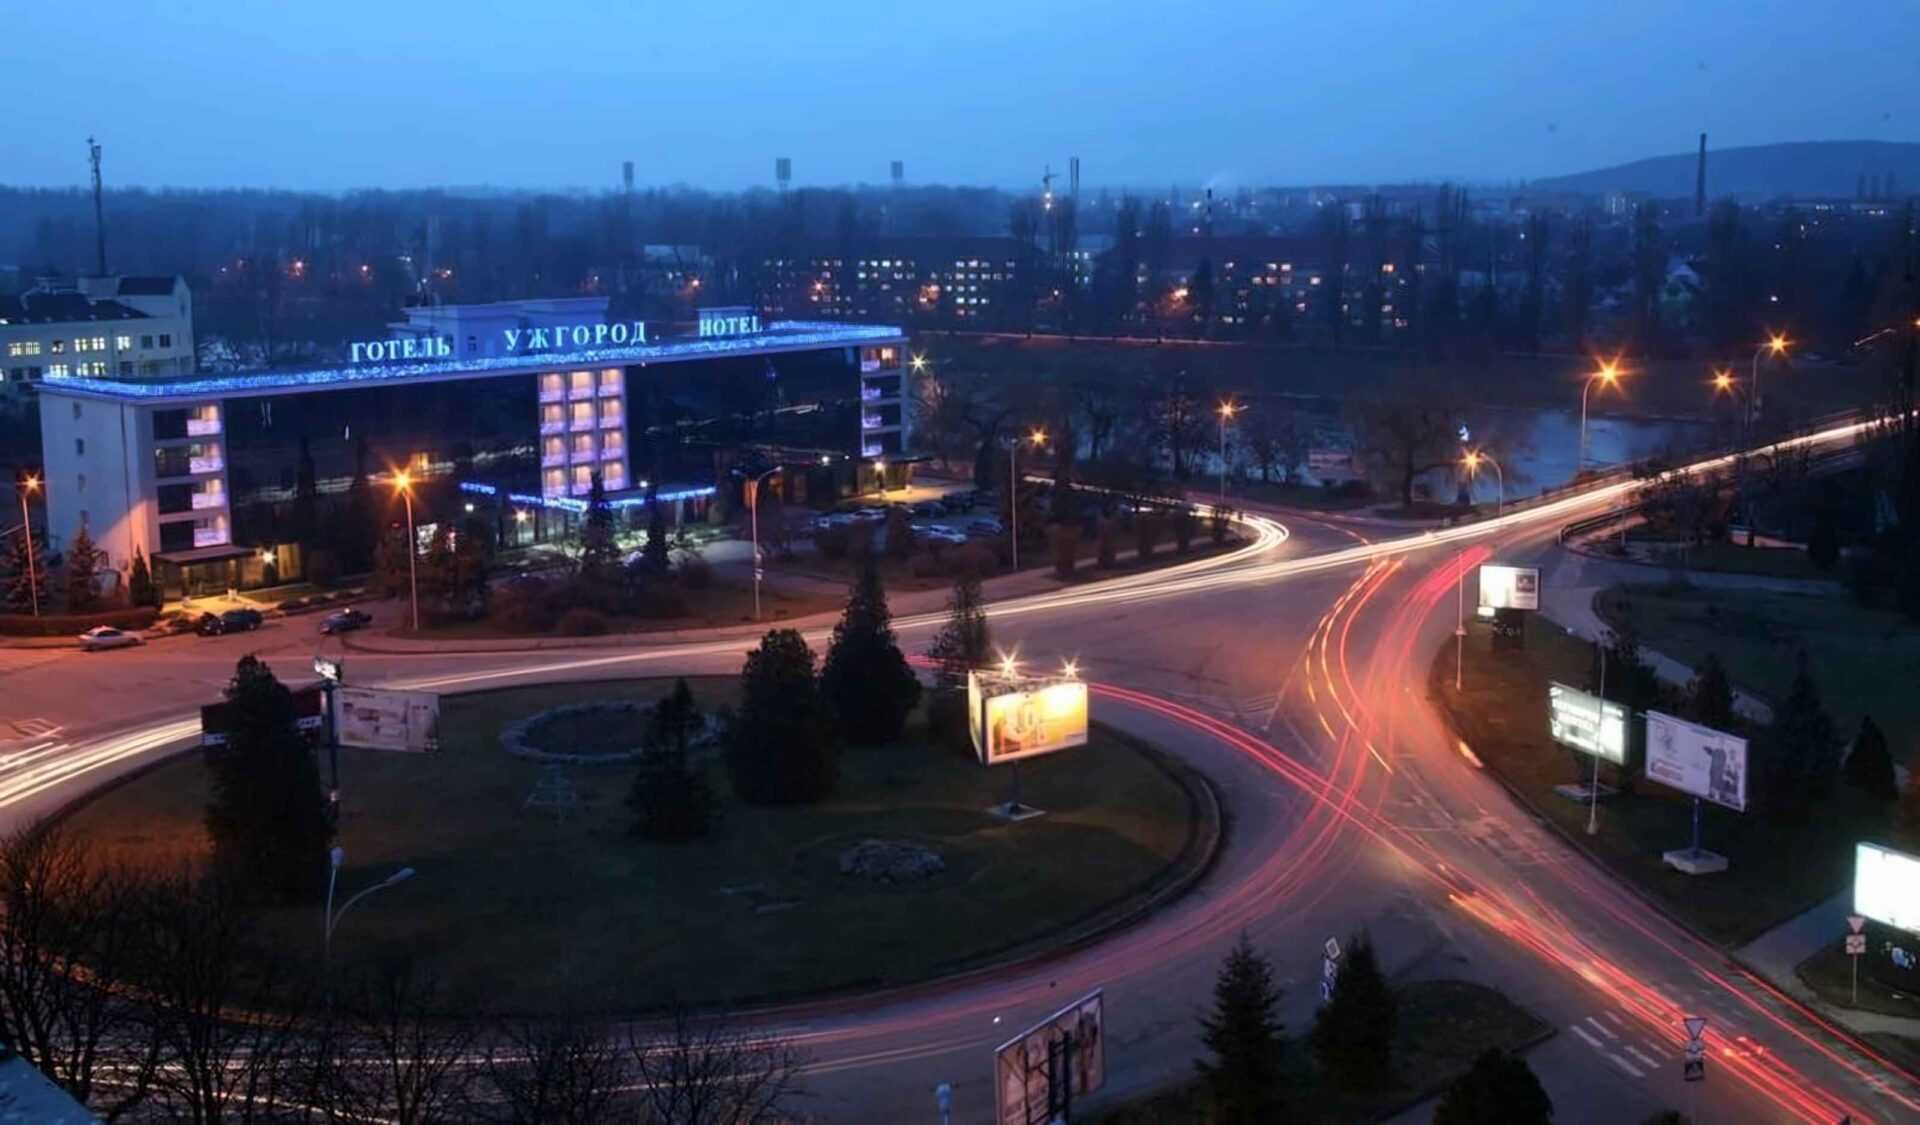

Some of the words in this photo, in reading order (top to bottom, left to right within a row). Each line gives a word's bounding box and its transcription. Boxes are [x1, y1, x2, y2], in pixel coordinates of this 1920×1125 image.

[699, 315, 763, 336] HOTEL
[352, 337, 450, 362] ГОТЕЛЬ
[504, 321, 647, 350] УЖГОРОД
